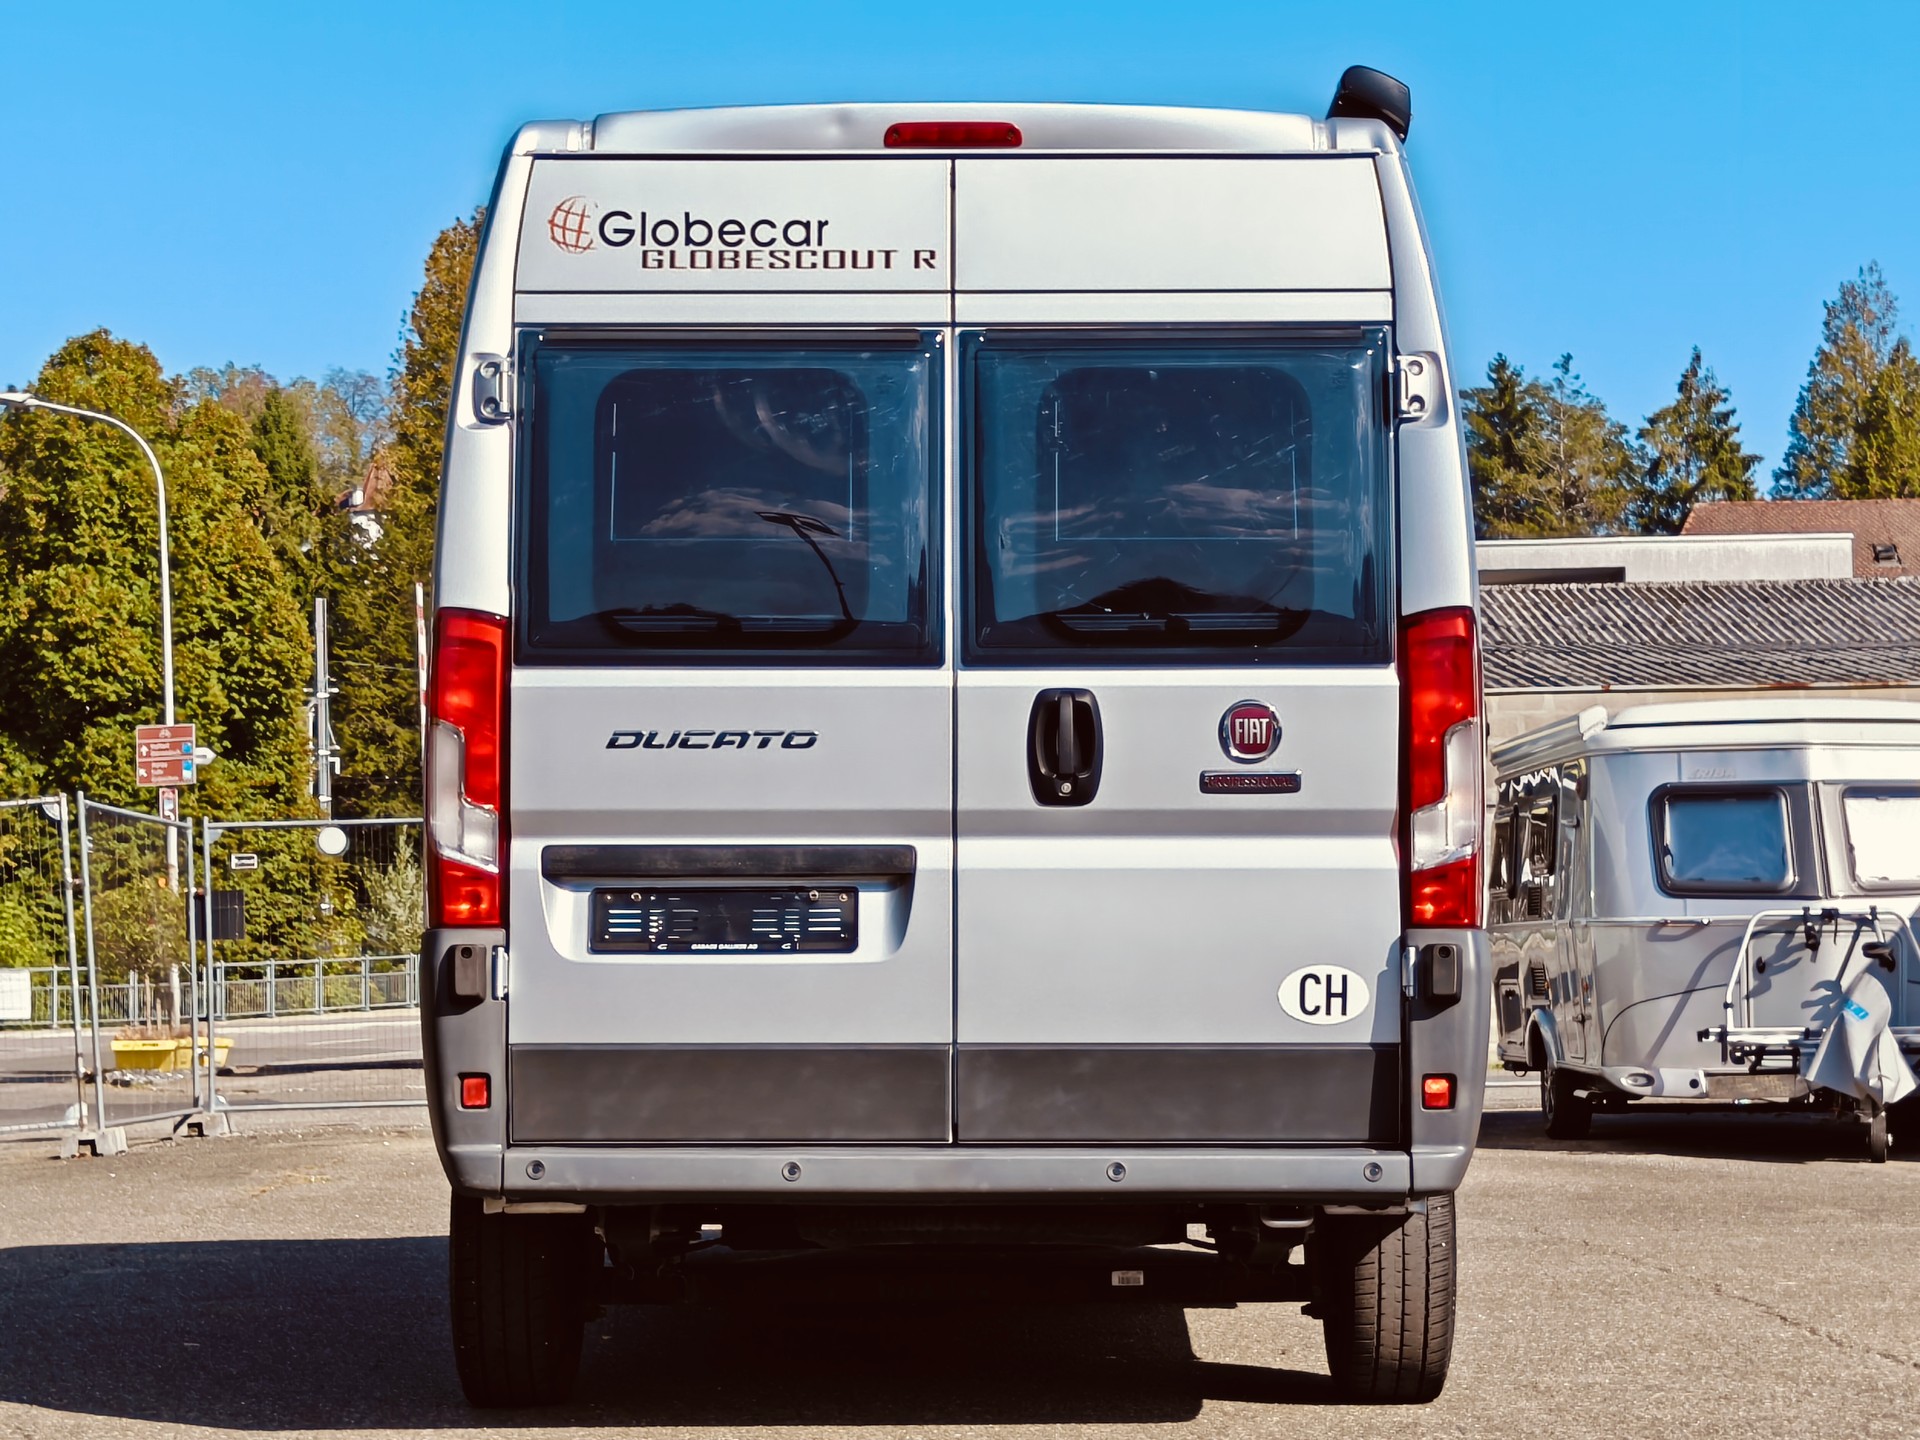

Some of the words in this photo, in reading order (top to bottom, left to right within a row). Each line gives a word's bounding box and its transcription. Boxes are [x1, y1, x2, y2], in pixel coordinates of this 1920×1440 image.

[599, 210, 829, 247] Globecar
[641, 249, 899, 270] GLOBESCOUT
[913, 249, 937, 270] R
[605, 729, 819, 749] DUCATO
[1234, 718, 1270, 744] FIAT
[1204, 775, 1294, 788] PROFESSIONAL
[1299, 973, 1348, 1016] CH
